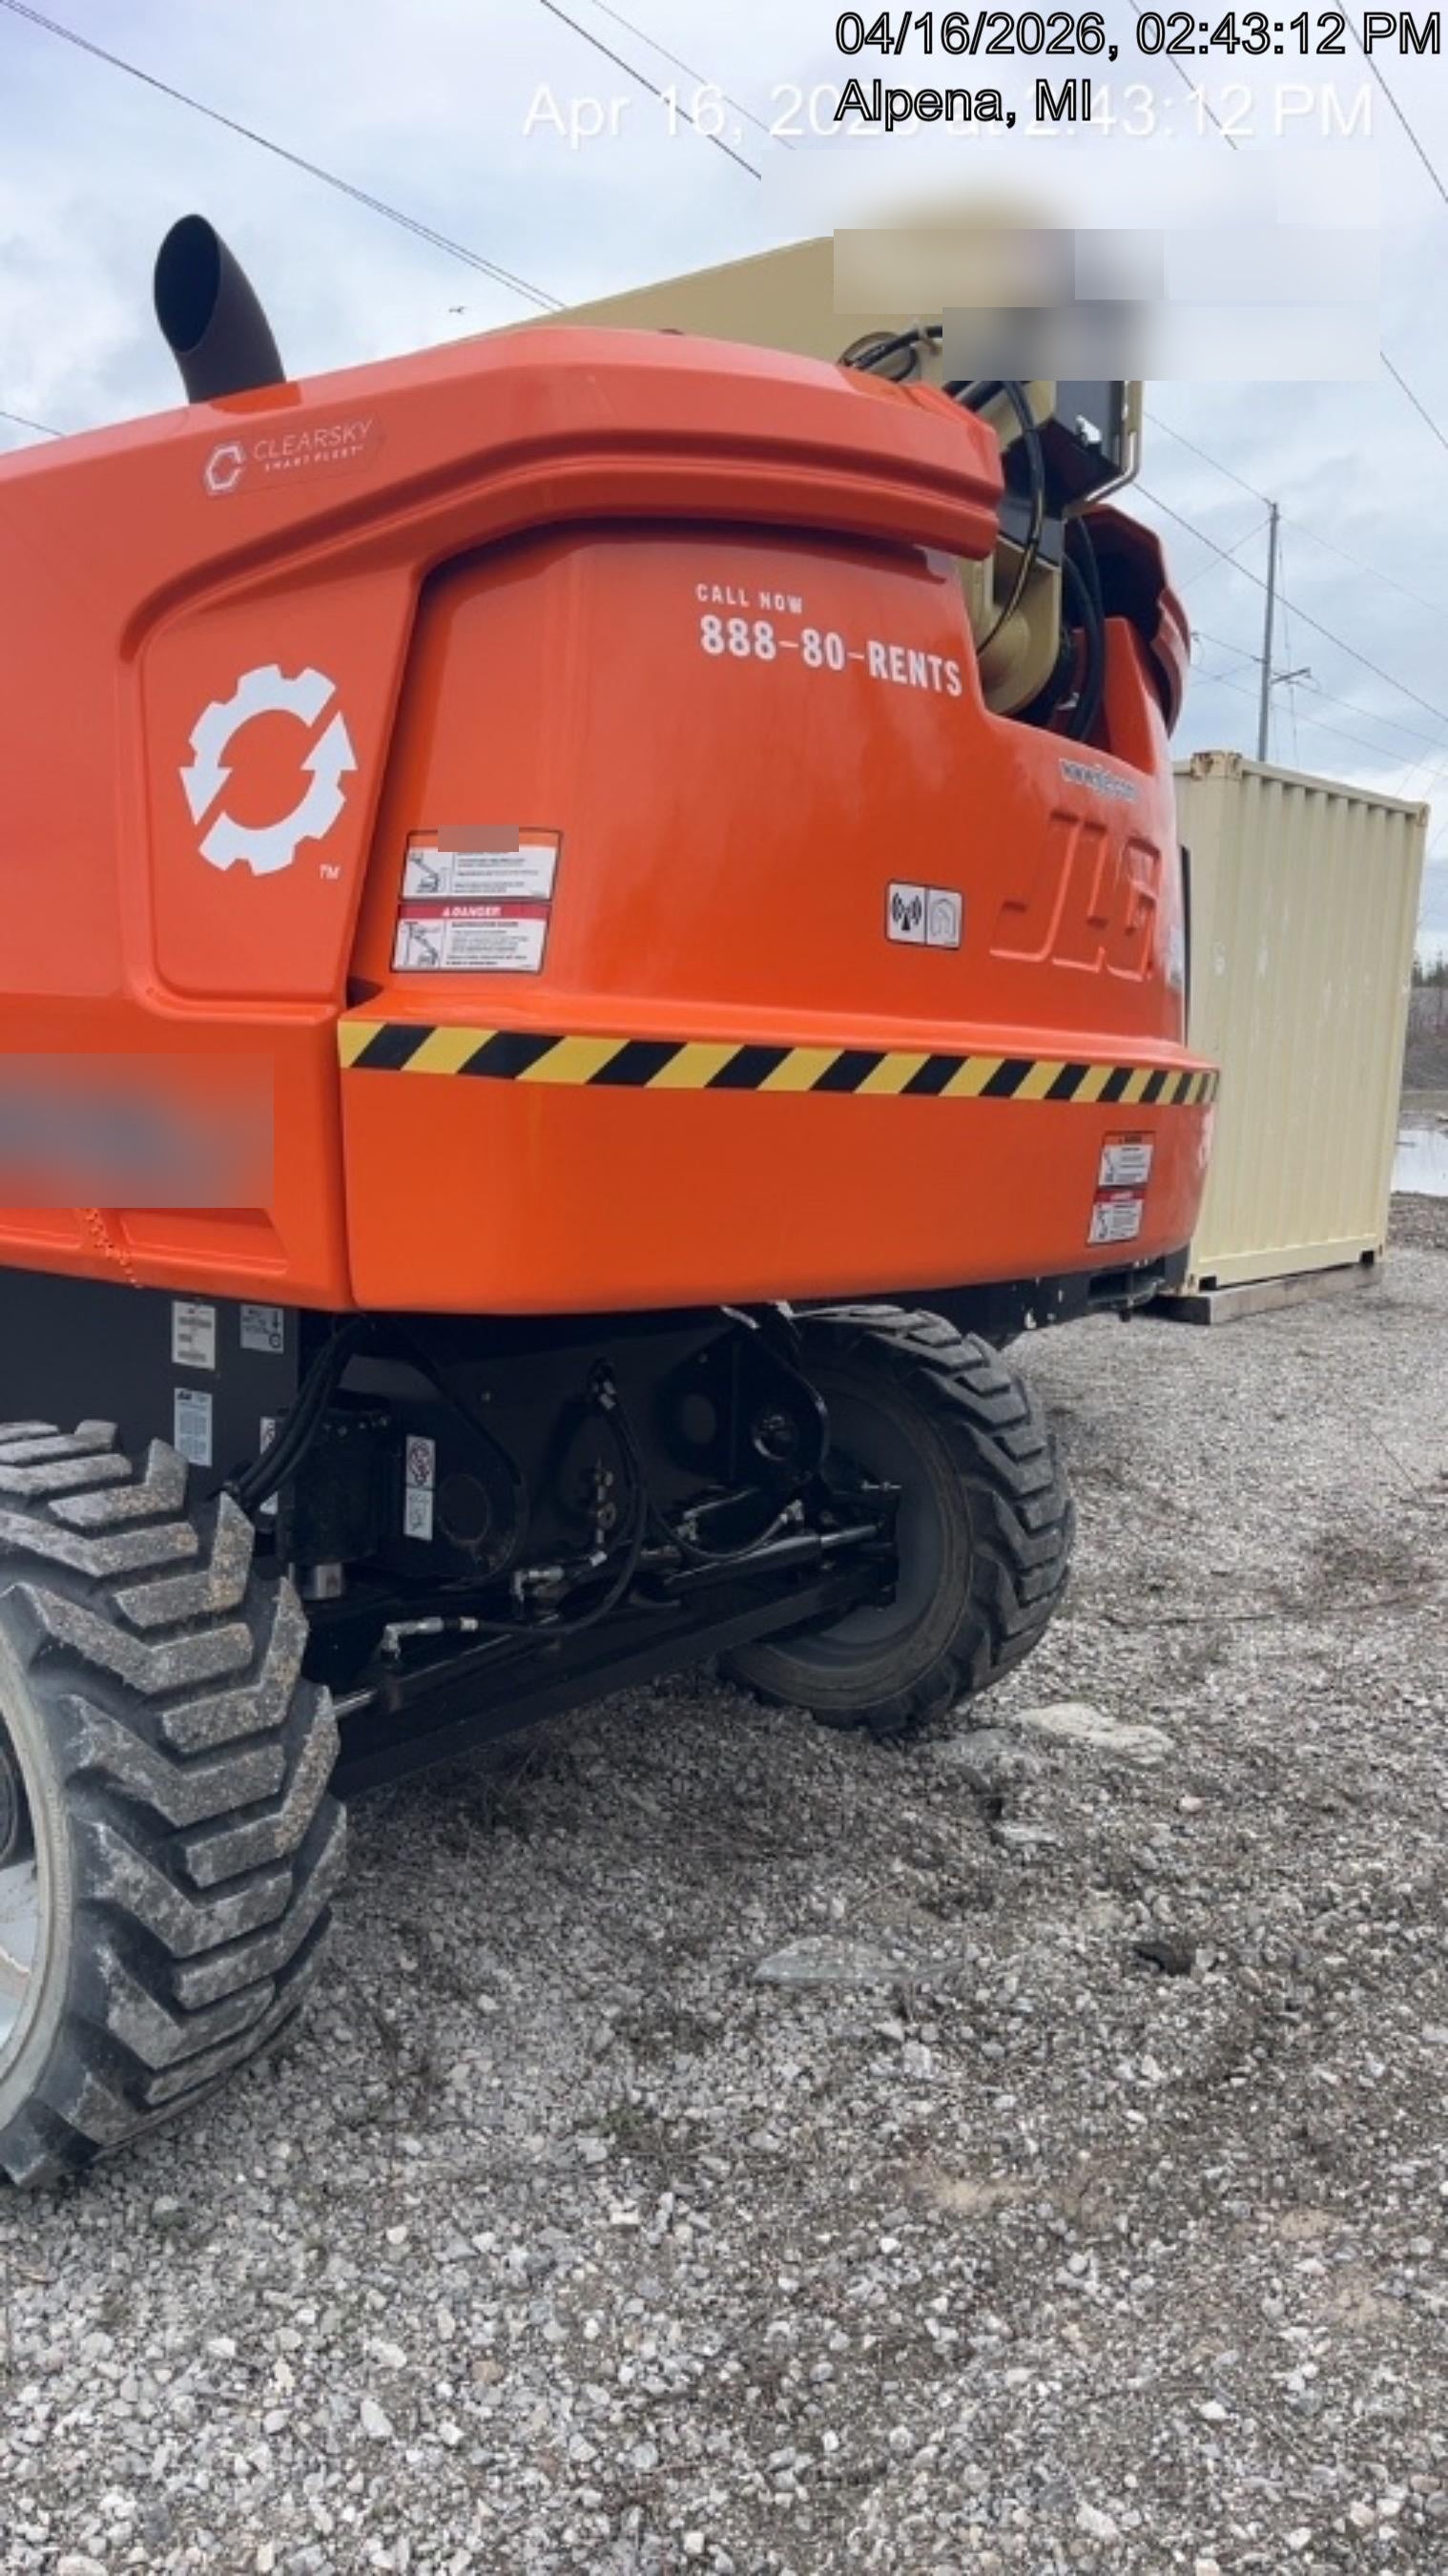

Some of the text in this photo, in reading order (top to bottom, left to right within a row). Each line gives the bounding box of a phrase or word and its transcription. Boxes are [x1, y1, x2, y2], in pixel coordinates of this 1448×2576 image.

[254, 418, 373, 461] CLEARSKY
[695, 583, 802, 613] CALL NOW
[700, 614, 962, 696] 888-80-RENTS
